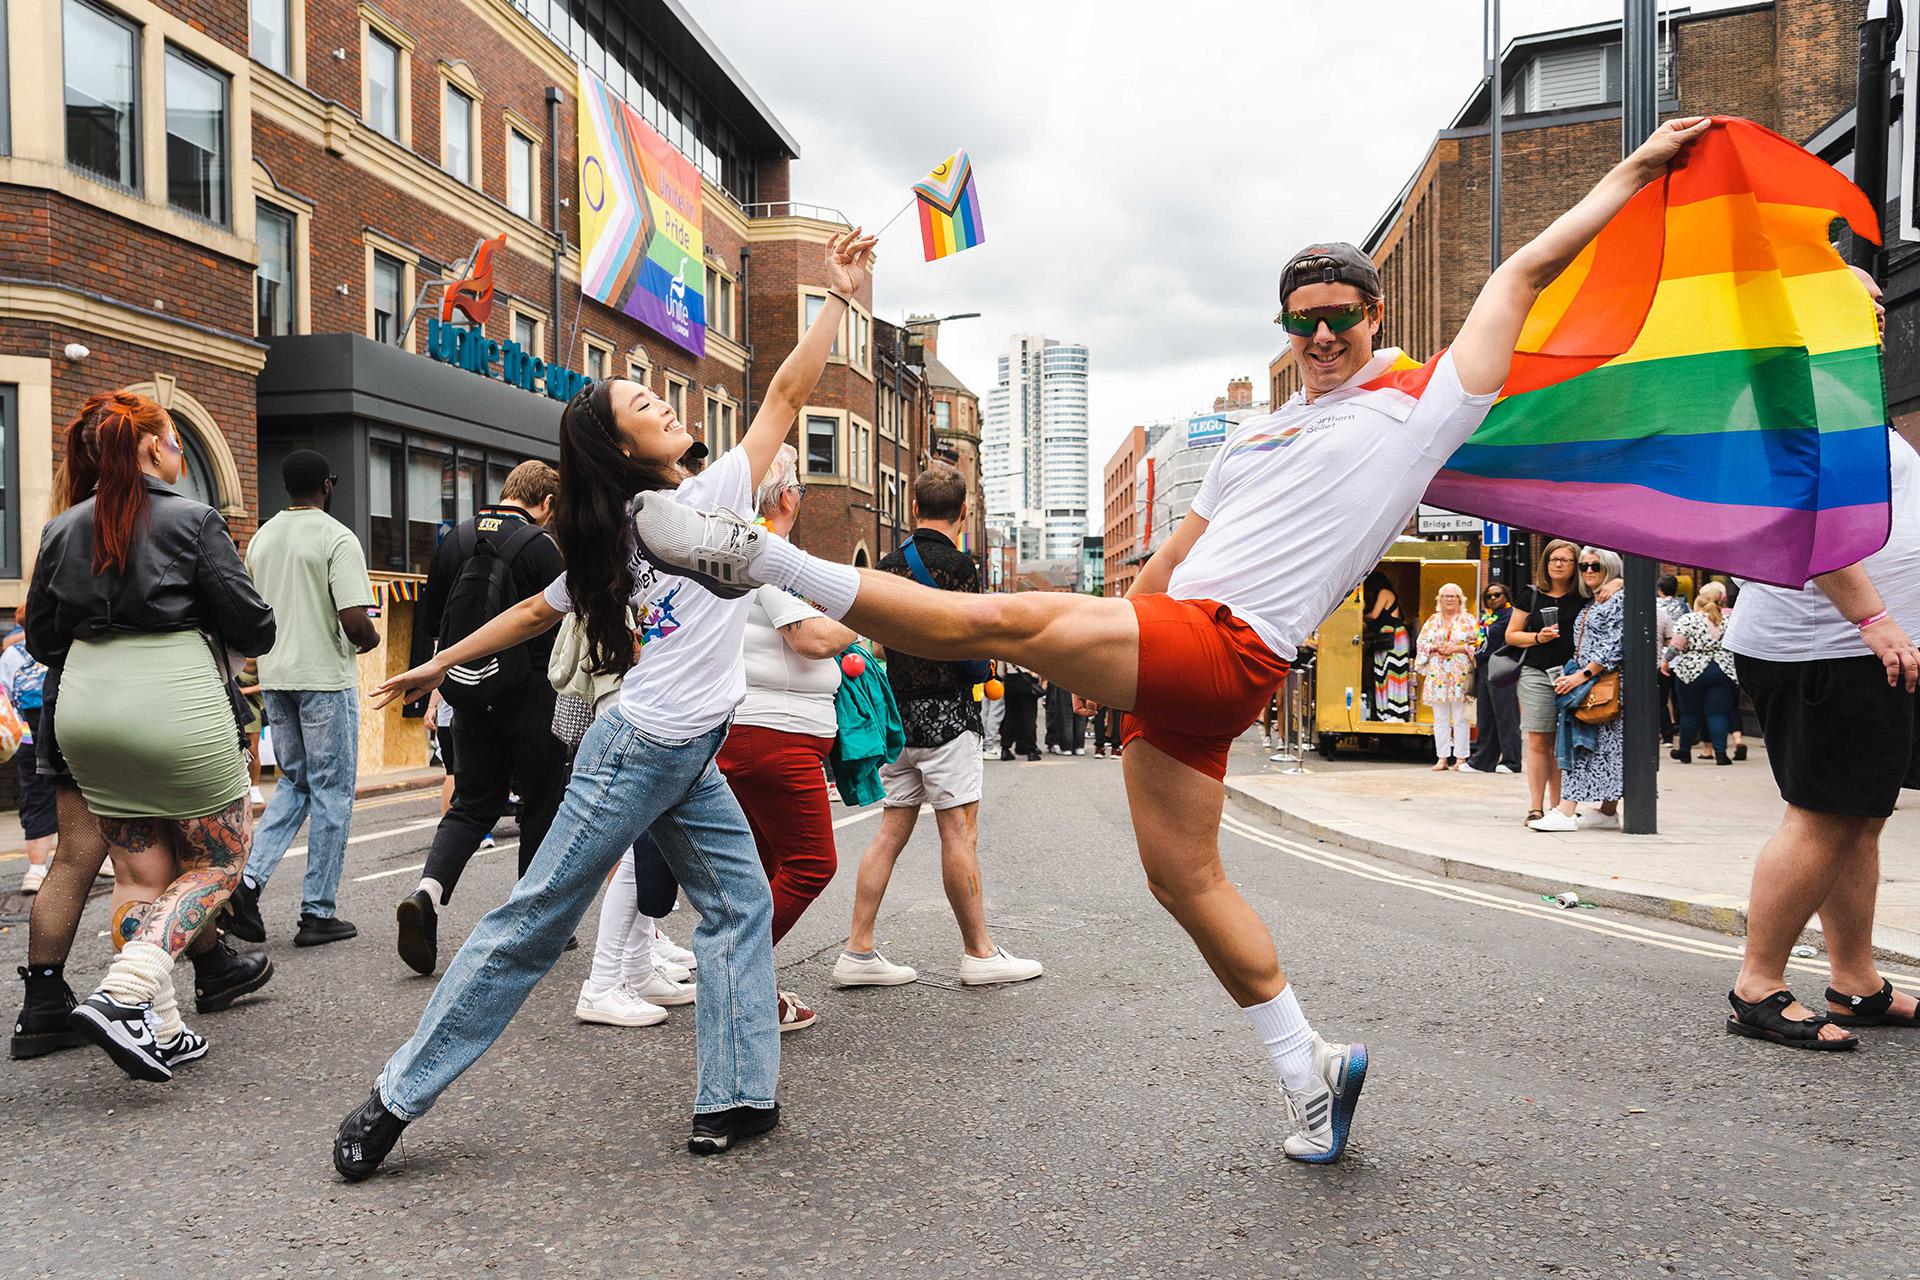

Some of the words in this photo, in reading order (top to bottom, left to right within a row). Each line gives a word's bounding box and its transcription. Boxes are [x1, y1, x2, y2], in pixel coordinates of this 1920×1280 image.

[658, 169, 684, 212] Unite
[685, 191, 696, 219] in
[665, 209, 690, 250] Pride
[501, 338, 546, 393] the
[1316, 413, 1356, 425] orthern
[1423, 520, 1452, 530] Bridge
[1455, 519, 1474, 528] End
